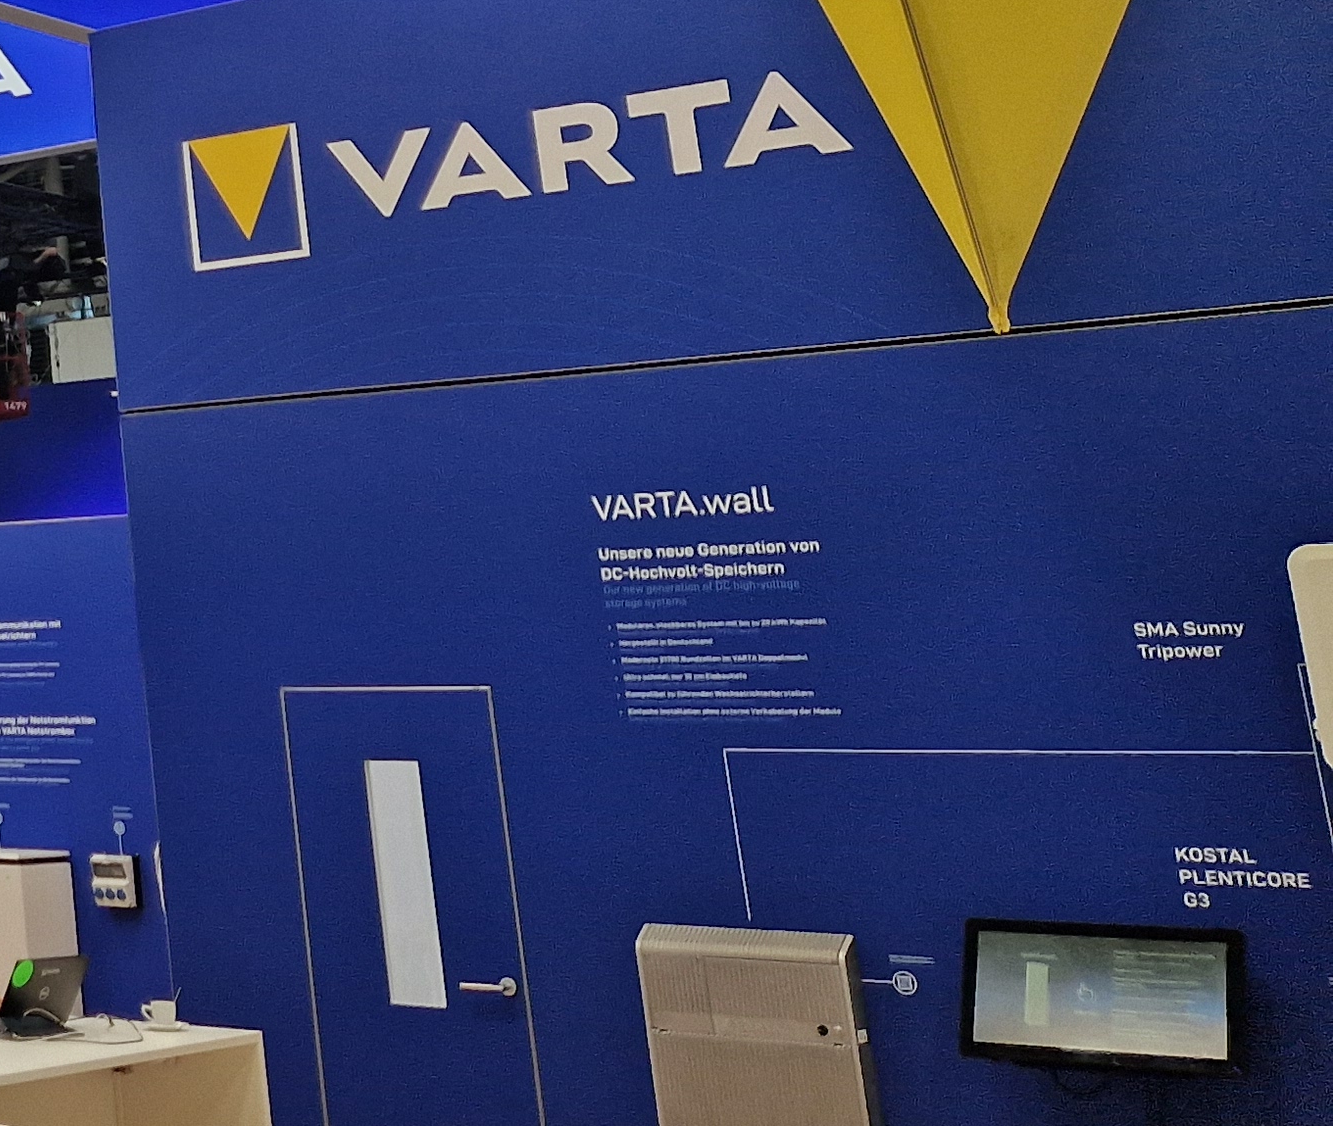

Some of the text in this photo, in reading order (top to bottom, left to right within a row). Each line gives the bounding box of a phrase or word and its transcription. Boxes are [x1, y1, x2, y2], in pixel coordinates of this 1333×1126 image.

[326, 71, 854, 218] VARTA
[591, 485, 775, 521] VARTA.wall
[598, 540, 820, 562] Unsere neue Generation von
[600, 562, 785, 582] DC-Hochvolt-Speichern
[1134, 621, 1244, 638] SMA Sunny
[1137, 643, 1223, 661] Tripower
[1174, 846, 1257, 865] KOSTAL
[1179, 869, 1313, 889] PLENTICORE
[1184, 892, 1211, 909] G3
